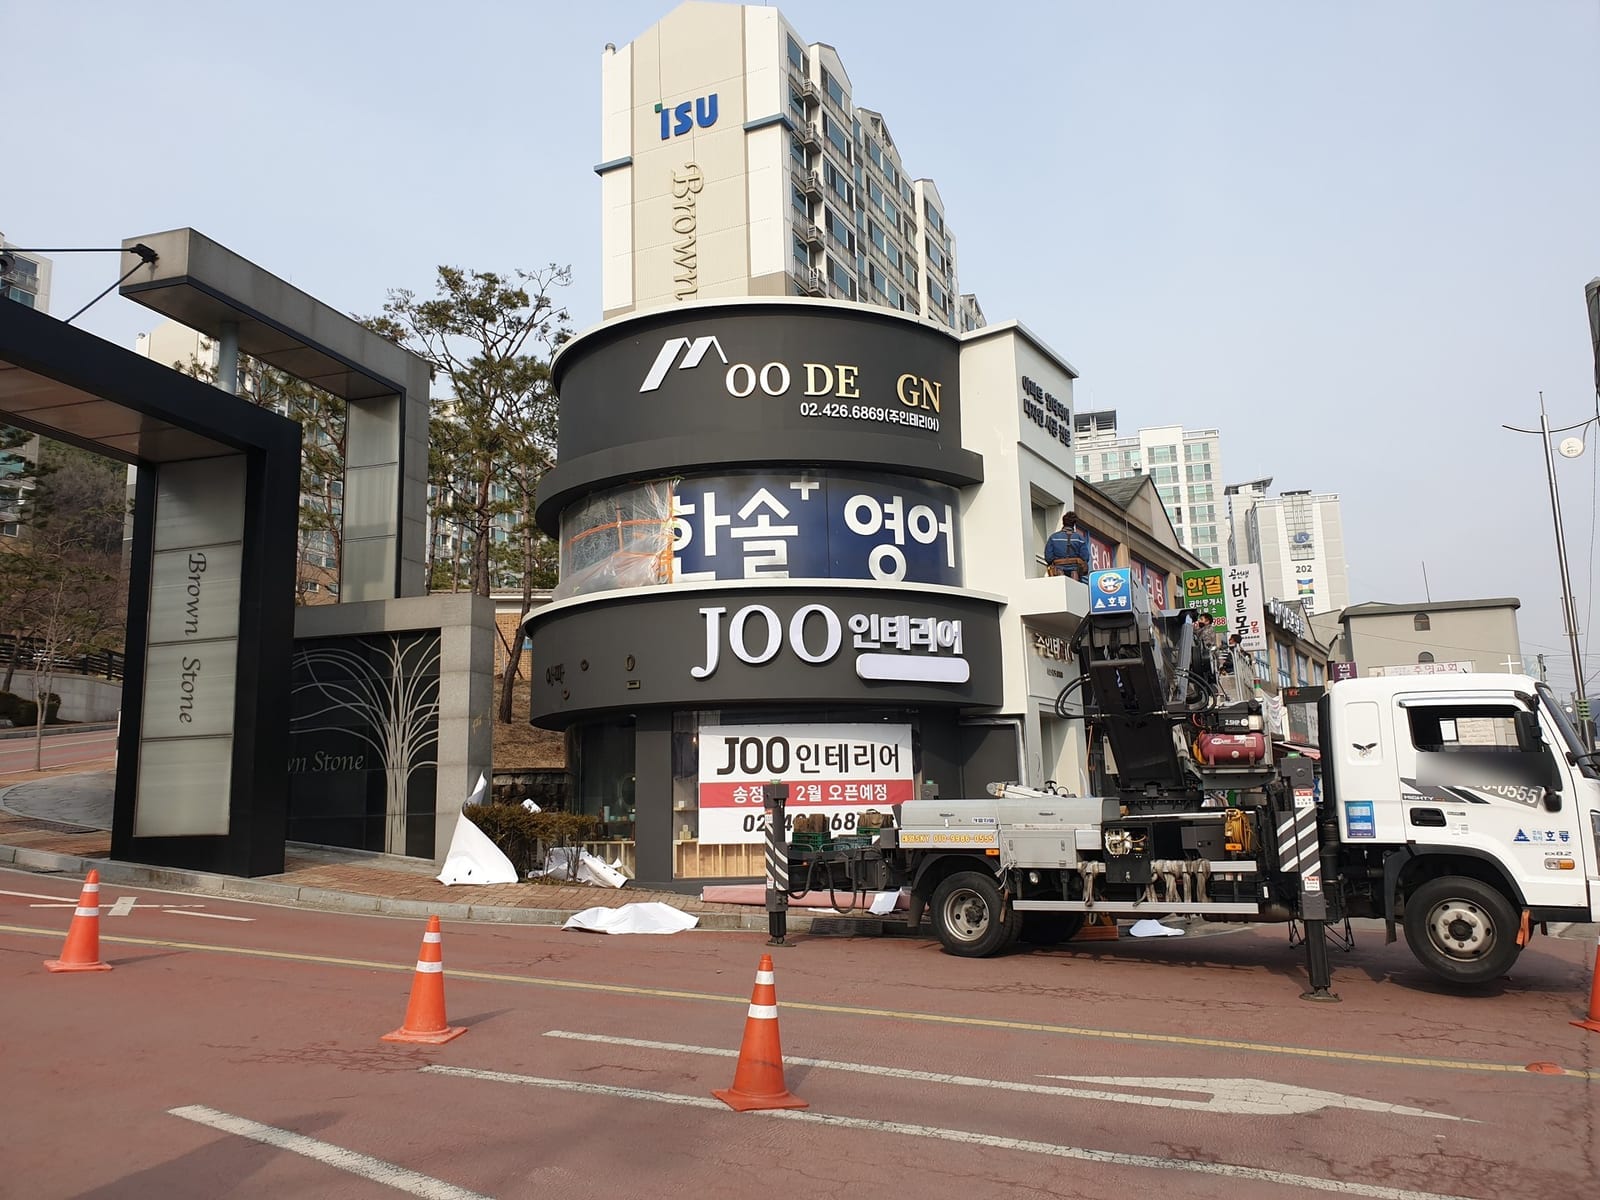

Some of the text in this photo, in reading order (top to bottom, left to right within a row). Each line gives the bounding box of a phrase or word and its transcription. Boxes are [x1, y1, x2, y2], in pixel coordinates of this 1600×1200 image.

[671, 161, 705, 301] Brown
[1021, 376, 1070, 426] 아파트 인테리어
[1023, 398, 1044, 428] 디자인
[844, 493, 956, 583] 영어
[1185, 575, 1222, 598] 한결
[1295, 564, 1313, 574] 202
[1188, 598, 1223, 609] 공인중개사
[179, 552, 207, 724] Brown Stone
[690, 604, 963, 679] JOO 인테리어
[312, 750, 364, 772] Stone
[716, 736, 899, 776] JOO 인테리어
[796, 784, 822, 803] 2월
[828, 783, 888, 802] 오픈예정
